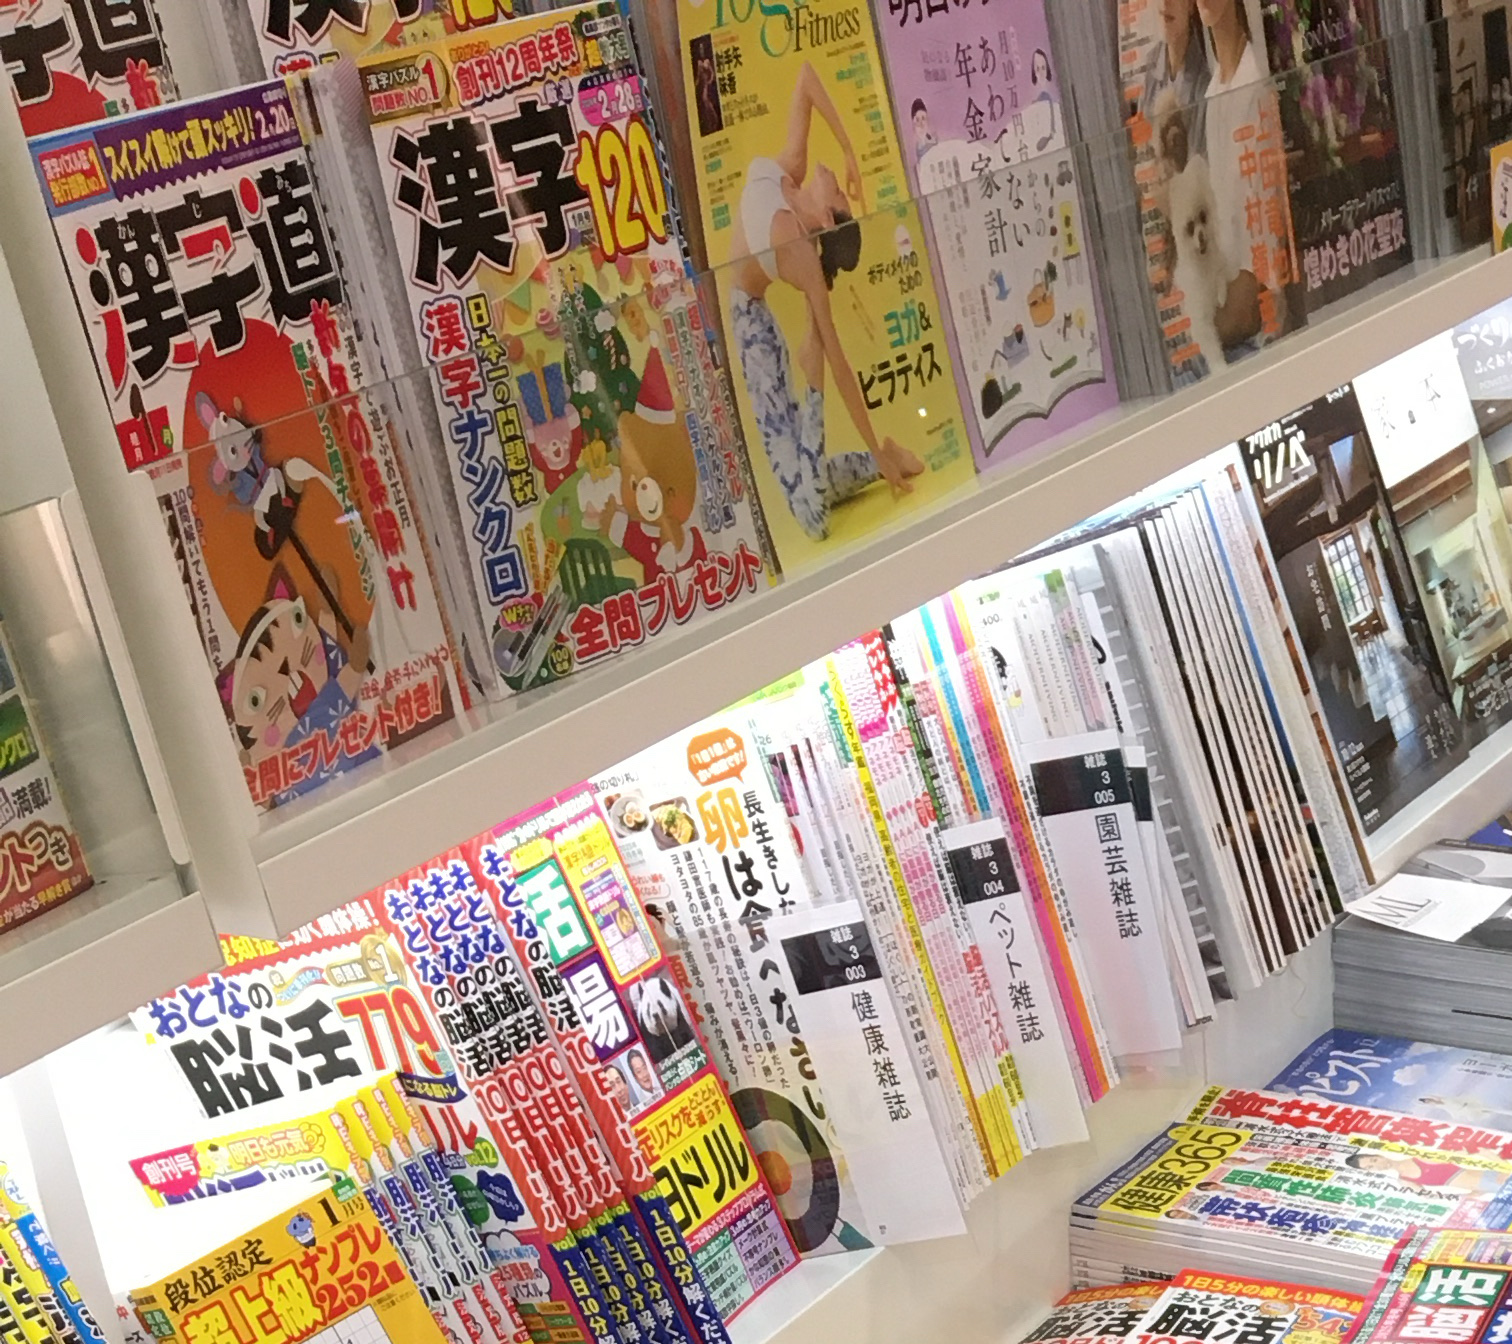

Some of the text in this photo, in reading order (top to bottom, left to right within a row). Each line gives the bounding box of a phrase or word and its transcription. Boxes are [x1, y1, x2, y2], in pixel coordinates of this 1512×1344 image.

[455, 24, 578, 102] 創刊12周年祭
[794, 6, 861, 52] Fitness
[393, 100, 591, 285] 漢字
[575, 117, 668, 261] 120
[75, 160, 342, 390] 漢字道
[466, 295, 537, 506] 日本一の問題数
[858, 343, 942, 410] ピラティス
[425, 299, 528, 600] 漢字ナンクロ
[1254, 430, 1312, 488] リノベ
[570, 543, 762, 660] 全問プレゼント
[1084, 752, 1107, 771] 雑誌
[1094, 789, 1116, 805] 005
[972, 843, 994, 859] 雑誌
[984, 881, 1005, 895] 004
[1095, 811, 1141, 938] 園芸雑誌
[831, 928, 854, 943] 雑誌
[846, 964, 866, 980] 003
[150, 975, 273, 1038] おとなの
[989, 903, 1044, 1044] ペット雑誌
[170, 999, 362, 1118] 脳活
[851, 991, 911, 1122] 健康雑誌
[142, 1153, 196, 1185] 創刊号
[1111, 1130, 1242, 1215] 健康365
[164, 1238, 273, 1313] 段位認定
[300, 1226, 383, 1280] ナンプレ
[1172, 1290, 1258, 1313] おとなの
[1401, 1268, 1505, 1344] 脳活
